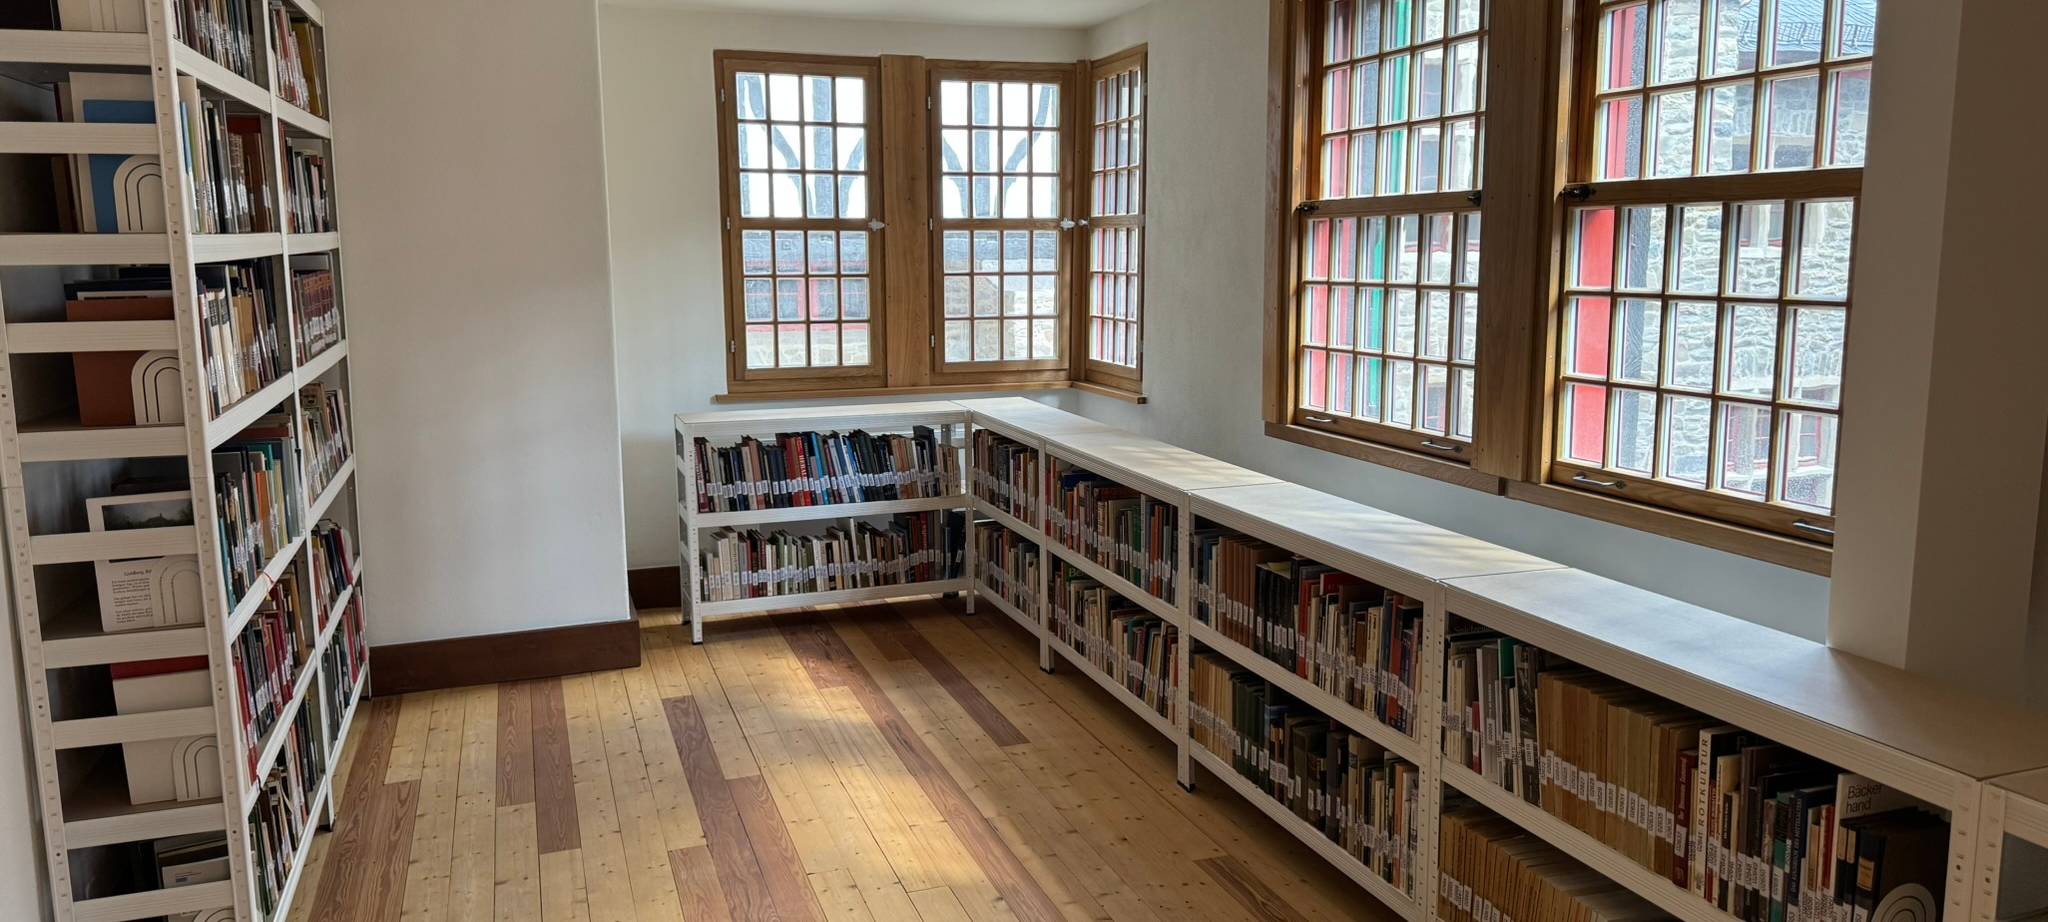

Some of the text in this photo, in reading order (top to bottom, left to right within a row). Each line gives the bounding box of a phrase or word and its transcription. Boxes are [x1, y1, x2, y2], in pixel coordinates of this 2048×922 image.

[1698, 738, 1709, 827] ROTKULTUR
[1848, 783, 1882, 799] Bäcker
[1846, 797, 1872, 814] hand
